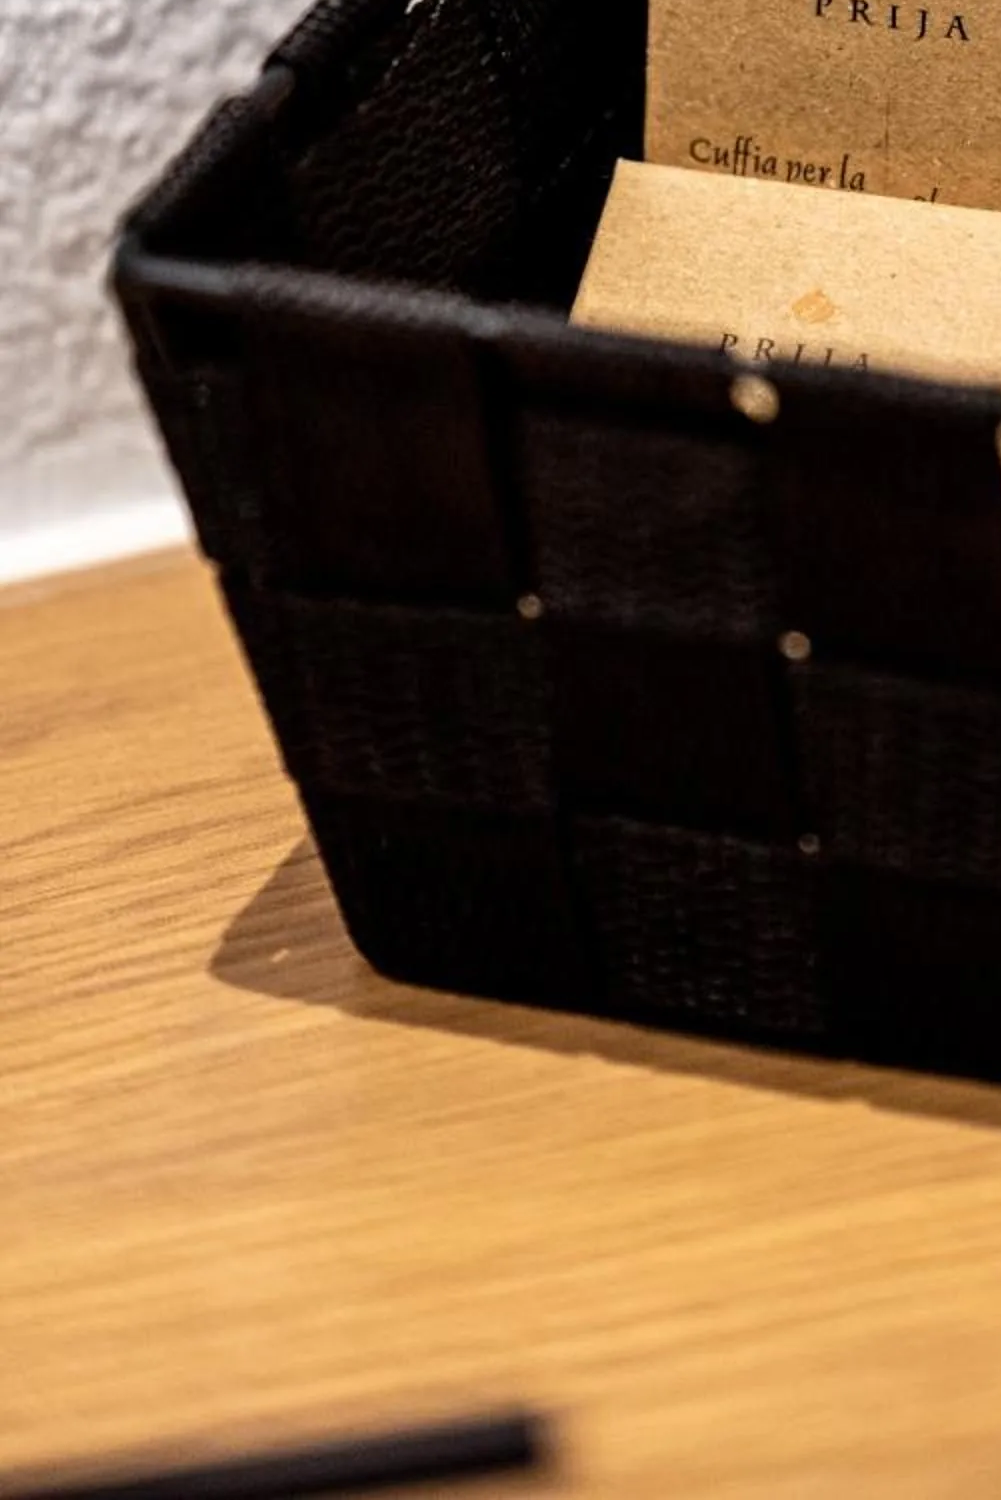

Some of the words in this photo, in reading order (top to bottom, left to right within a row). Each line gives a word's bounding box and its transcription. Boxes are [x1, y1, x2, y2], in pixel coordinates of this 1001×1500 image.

[689, 135, 778, 176] Cuffia
[786, 159, 832, 184] per
[838, 154, 866, 191] la
